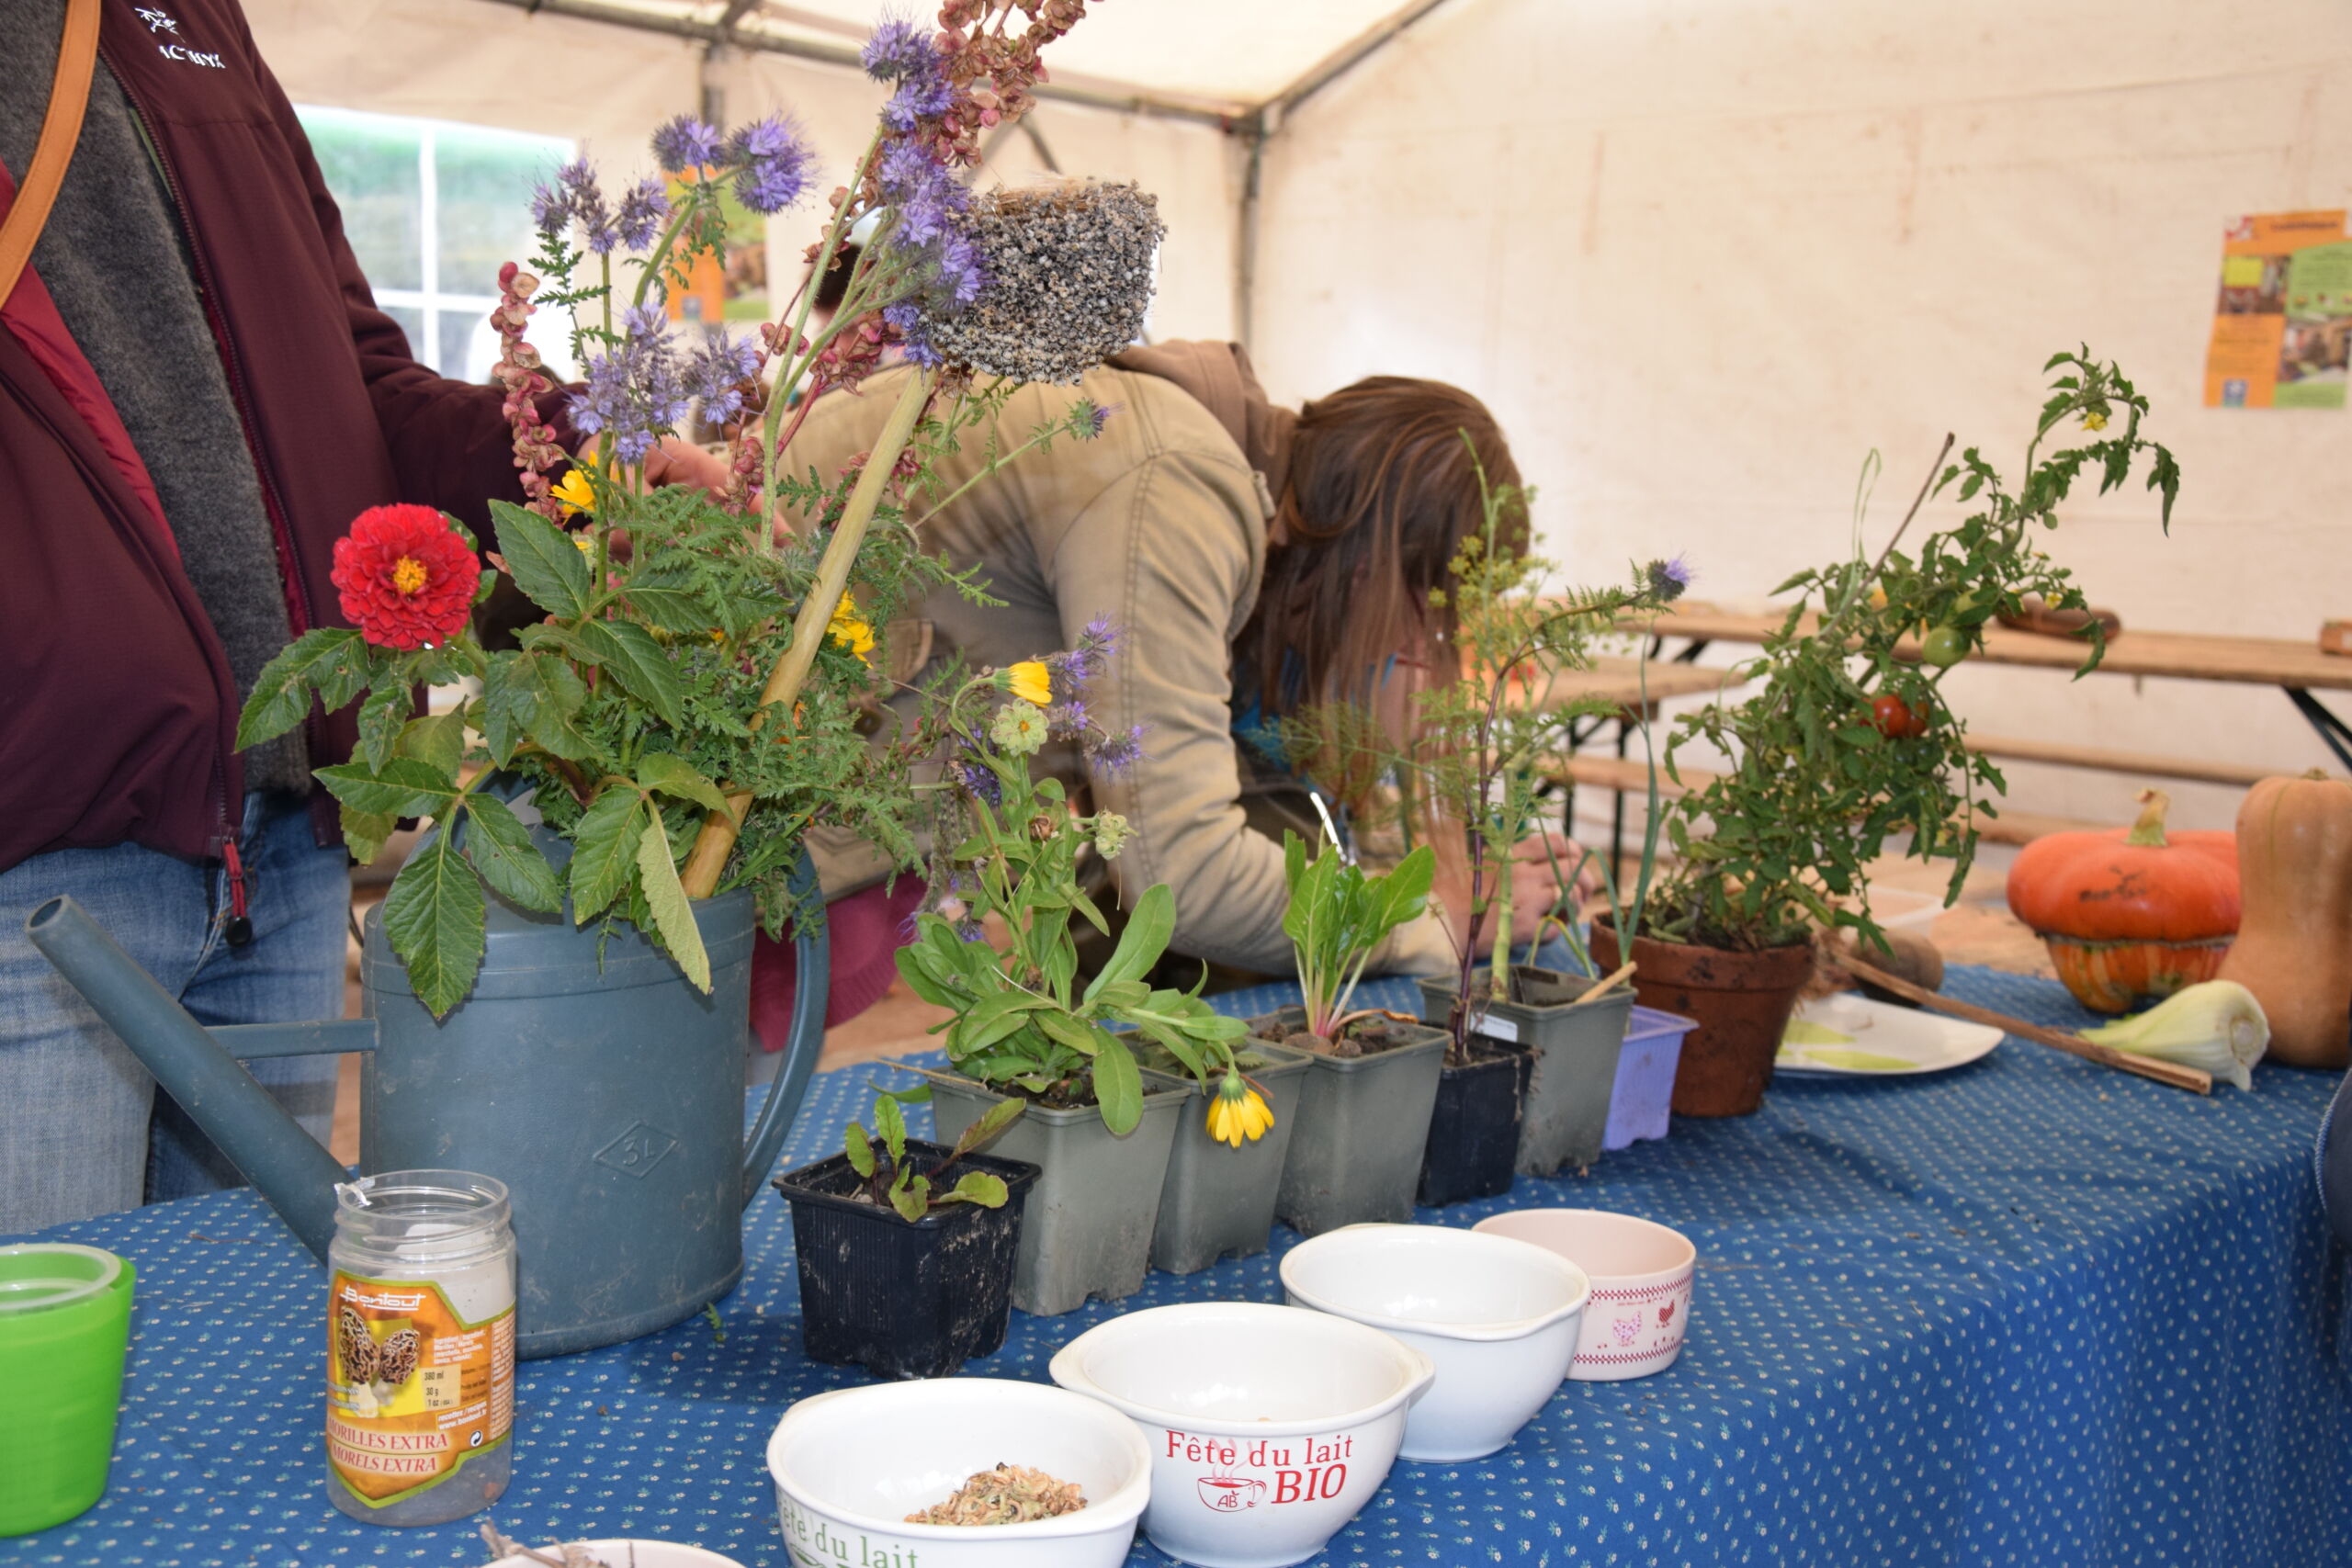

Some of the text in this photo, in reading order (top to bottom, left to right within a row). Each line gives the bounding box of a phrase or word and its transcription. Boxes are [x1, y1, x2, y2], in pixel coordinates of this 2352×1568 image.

[339, 1284, 426, 1308] Bontout
[436, 1371, 445, 1379] ml
[426, 1387, 439, 1397] 30 g
[390, 1433, 448, 1450] EXTRA
[1166, 1430, 1353, 1467] Fête du lait
[332, 1443, 436, 1472] MORELS EXTRA
[1271, 1463, 1347, 1505] BIO
[1217, 1495, 1238, 1508] AB
[815, 1523, 849, 1561] du
[860, 1535, 919, 1568] lait
